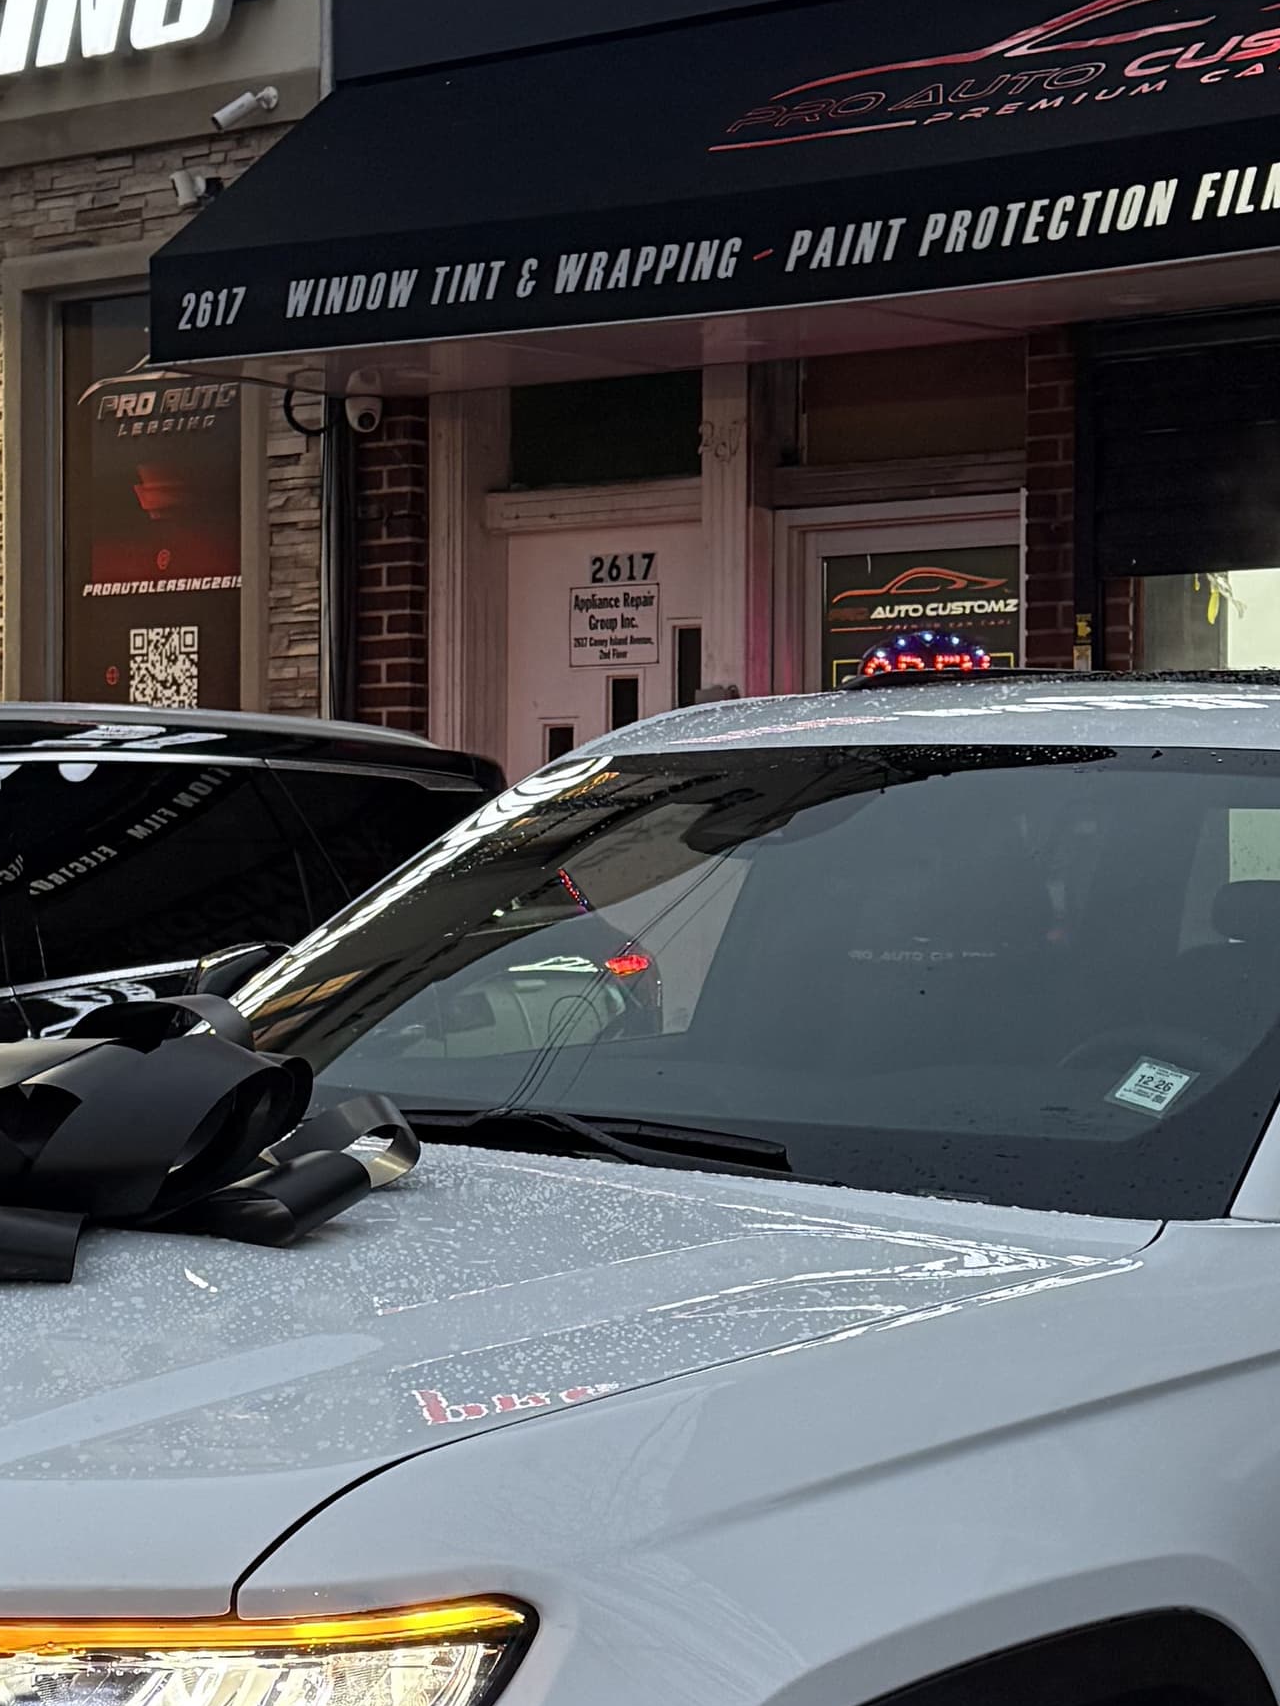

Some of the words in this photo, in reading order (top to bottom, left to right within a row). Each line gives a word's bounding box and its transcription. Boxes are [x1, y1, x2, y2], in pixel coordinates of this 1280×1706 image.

[726, 91, 887, 134] PRO
[887, 61, 1107, 112] AUTO
[922, 80, 1168, 126] PREMIUM
[176, 285, 247, 331] 2617
[284, 268, 419, 319] WINDOW
[429, 259, 505, 305] TINT
[516, 257, 539, 298] &
[553, 236, 743, 295] WRAPPING
[785, 218, 908, 274] PAINT
[919, 179, 1179, 258] PROTECTION
[97, 390, 157, 421] PRO
[159, 381, 241, 413] AUTO
[117, 413, 217, 437] LEASING
[591, 552, 657, 584] 2617
[573, 593, 621, 613] Appliance
[623, 590, 655, 610] Repair
[869, 603, 924, 620] AUTO
[925, 597, 1019, 618] CUSTOMZ
[588, 613, 618, 633] Group
[621, 612, 639, 630] Inc.
[1137, 1074, 1154, 1086] 12
[1154, 1079, 1175, 1092] 26
